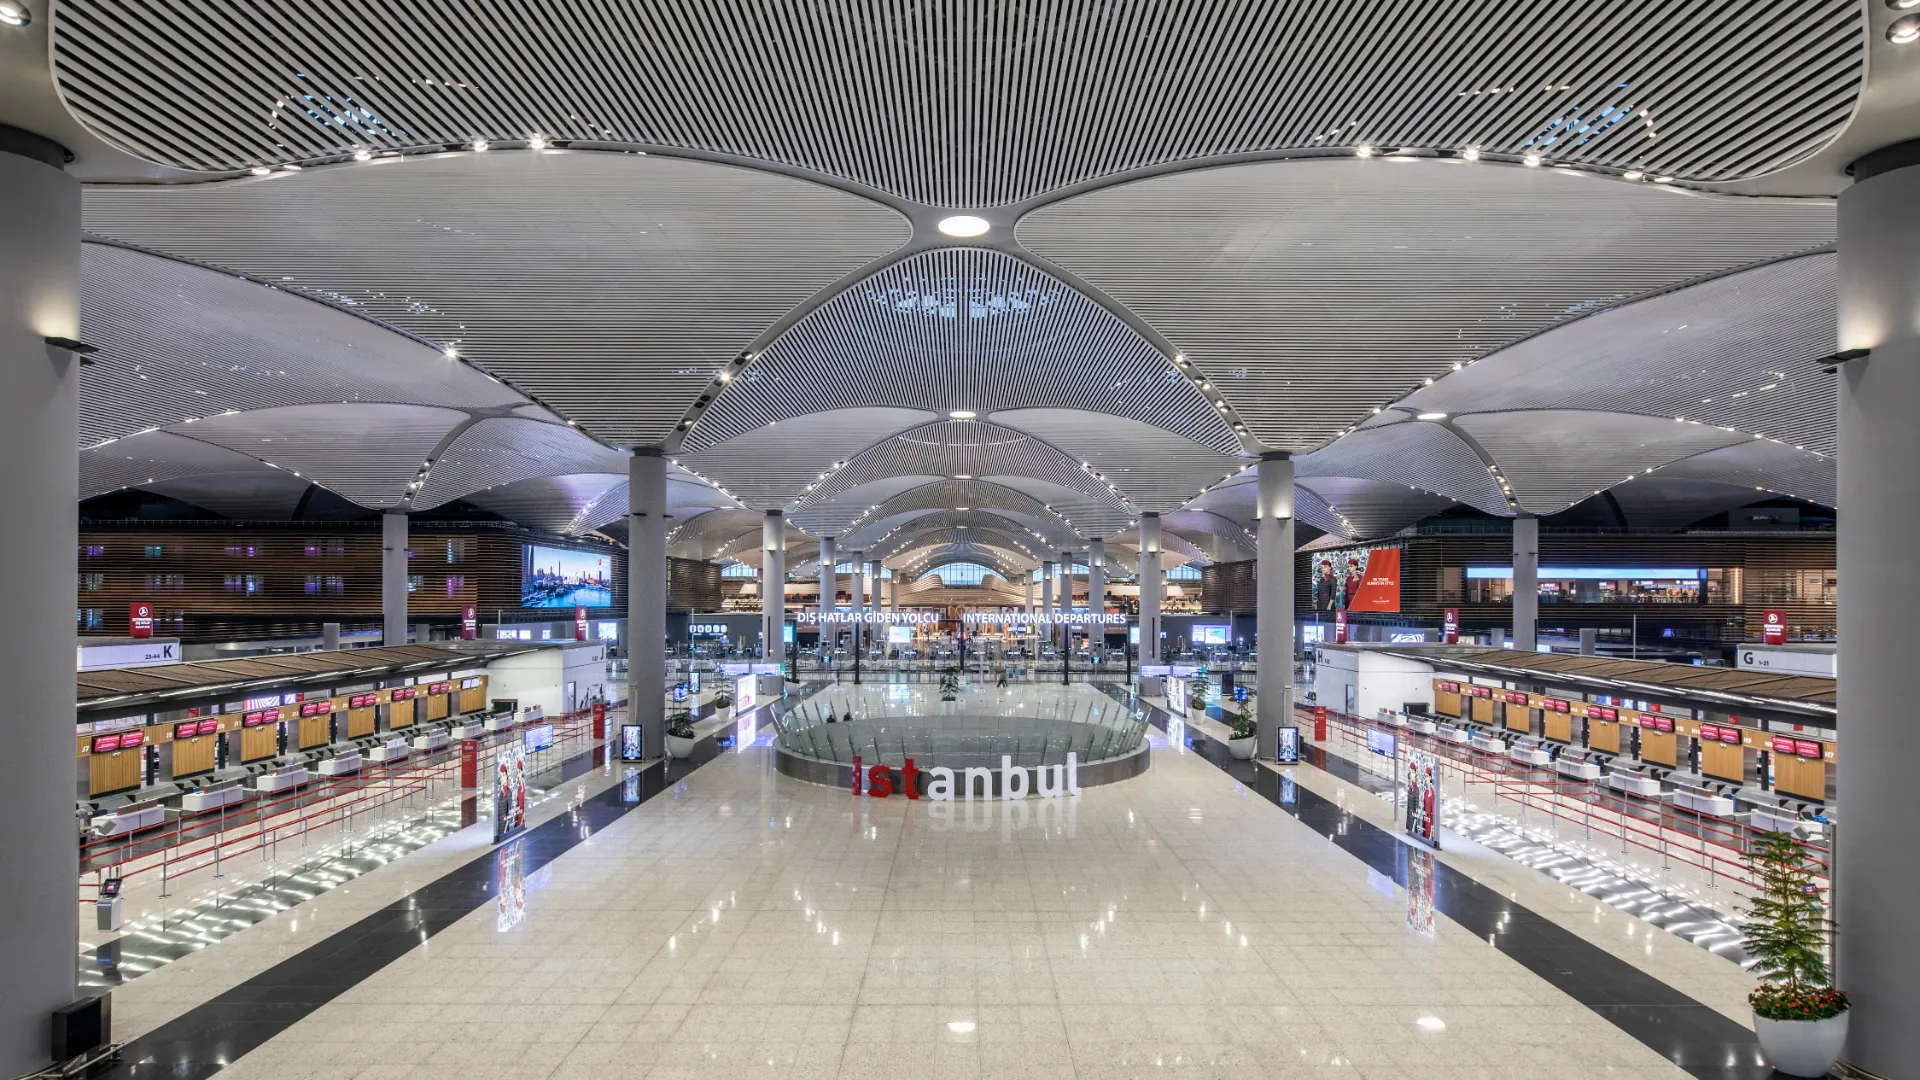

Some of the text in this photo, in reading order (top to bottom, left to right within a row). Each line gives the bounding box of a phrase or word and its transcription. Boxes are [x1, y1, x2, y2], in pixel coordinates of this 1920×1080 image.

[797, 611, 940, 624] DIŞ HATLAR GİDEN YOLCU
[963, 613, 1127, 624] INTERNATIONAL DEPARTURES
[163, 645, 172, 659] K
[1743, 652, 1754, 665] G
